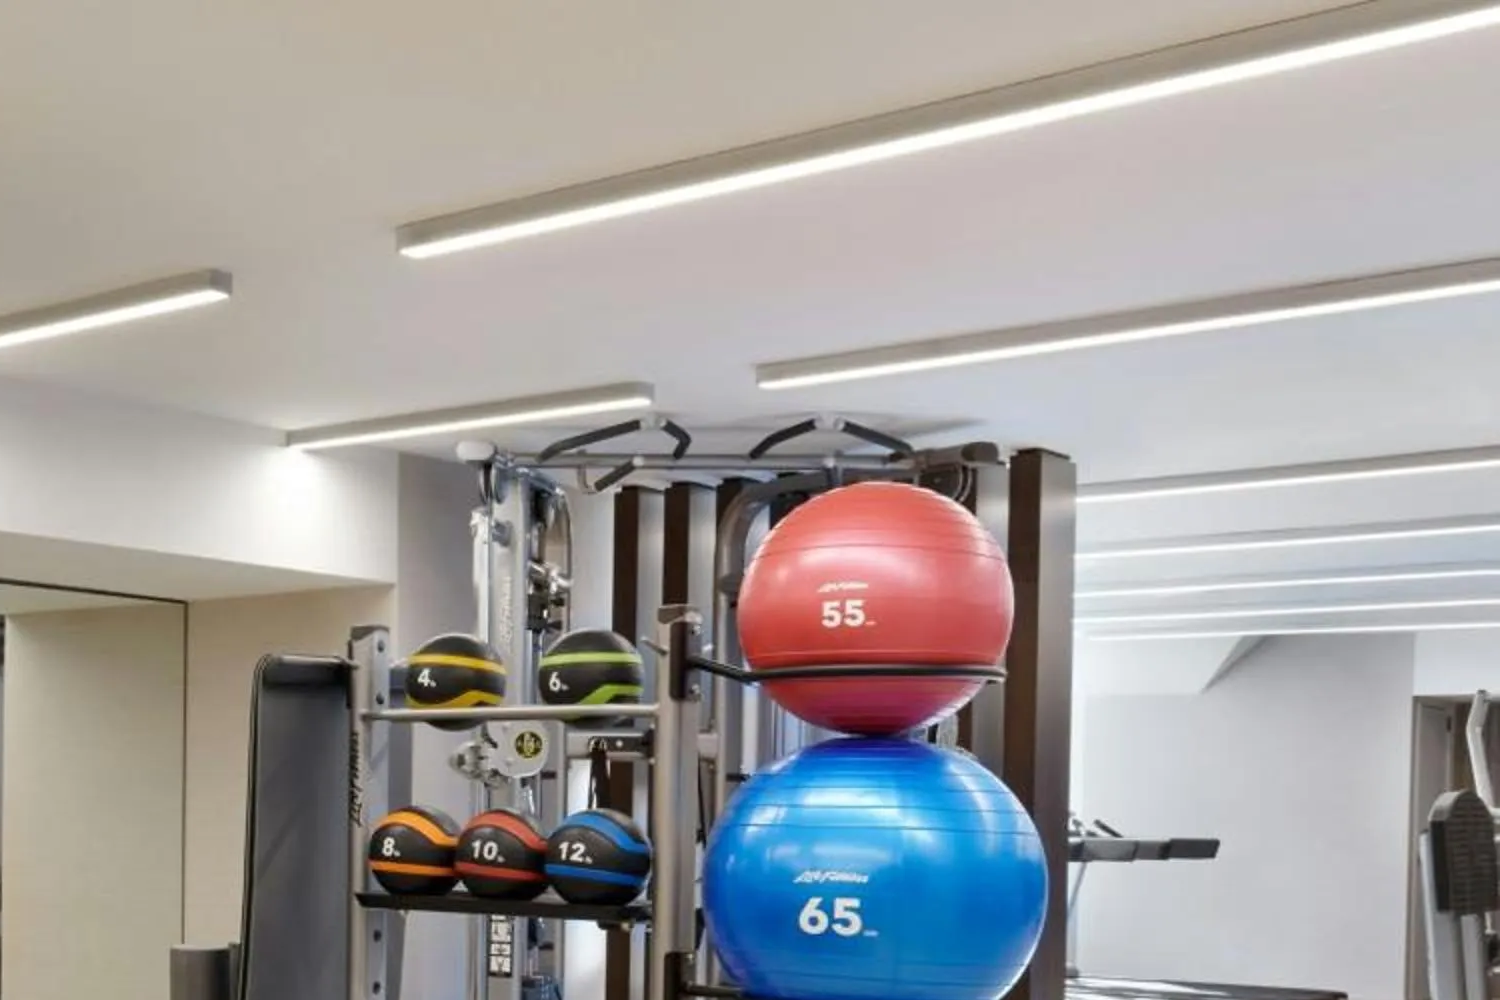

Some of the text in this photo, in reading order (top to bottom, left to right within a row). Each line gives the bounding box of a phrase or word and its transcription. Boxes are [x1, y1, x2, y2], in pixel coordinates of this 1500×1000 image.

[821, 599, 866, 629] 55
[472, 840, 498, 860] 10
[559, 841, 585, 862] 12
[799, 896, 863, 936] 65
